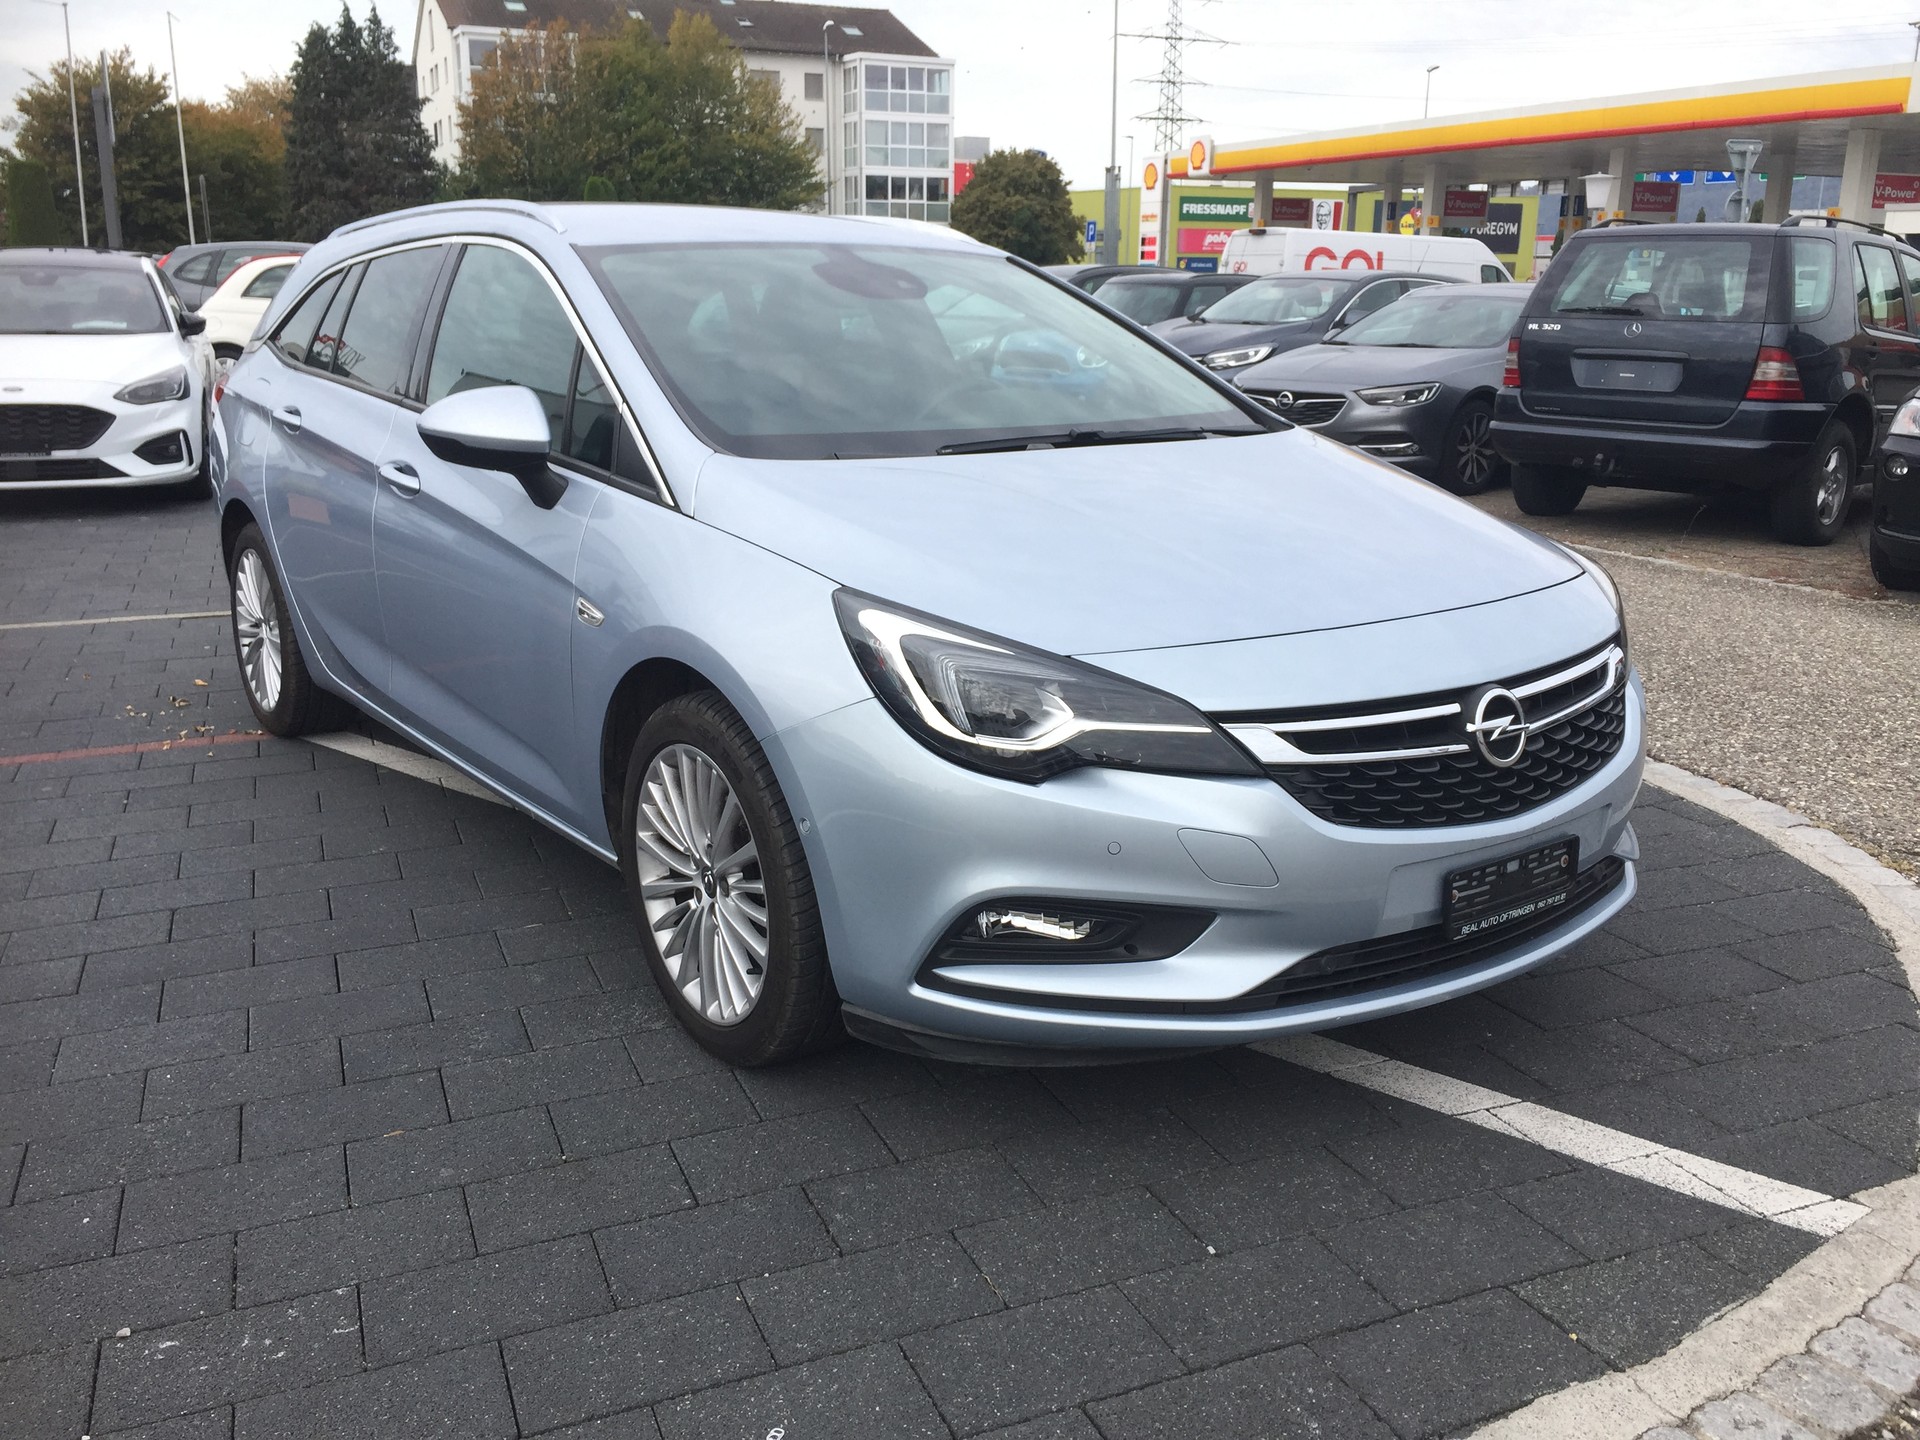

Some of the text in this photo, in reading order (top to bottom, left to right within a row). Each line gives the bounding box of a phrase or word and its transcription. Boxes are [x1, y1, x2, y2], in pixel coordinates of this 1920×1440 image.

[1635, 192, 1673, 203] V-Power
[1875, 186, 1916, 198] V-Power
[1182, 203, 1247, 215] FRESSNAPF
[1448, 200, 1482, 209] V-Power
[1088, 224, 1095, 241] P
[1542, 323, 1561, 331] 320
[1461, 923, 1478, 934] REAL
[1480, 915, 1499, 929] AUTO
[1500, 903, 1536, 922] OFTRINGEN
